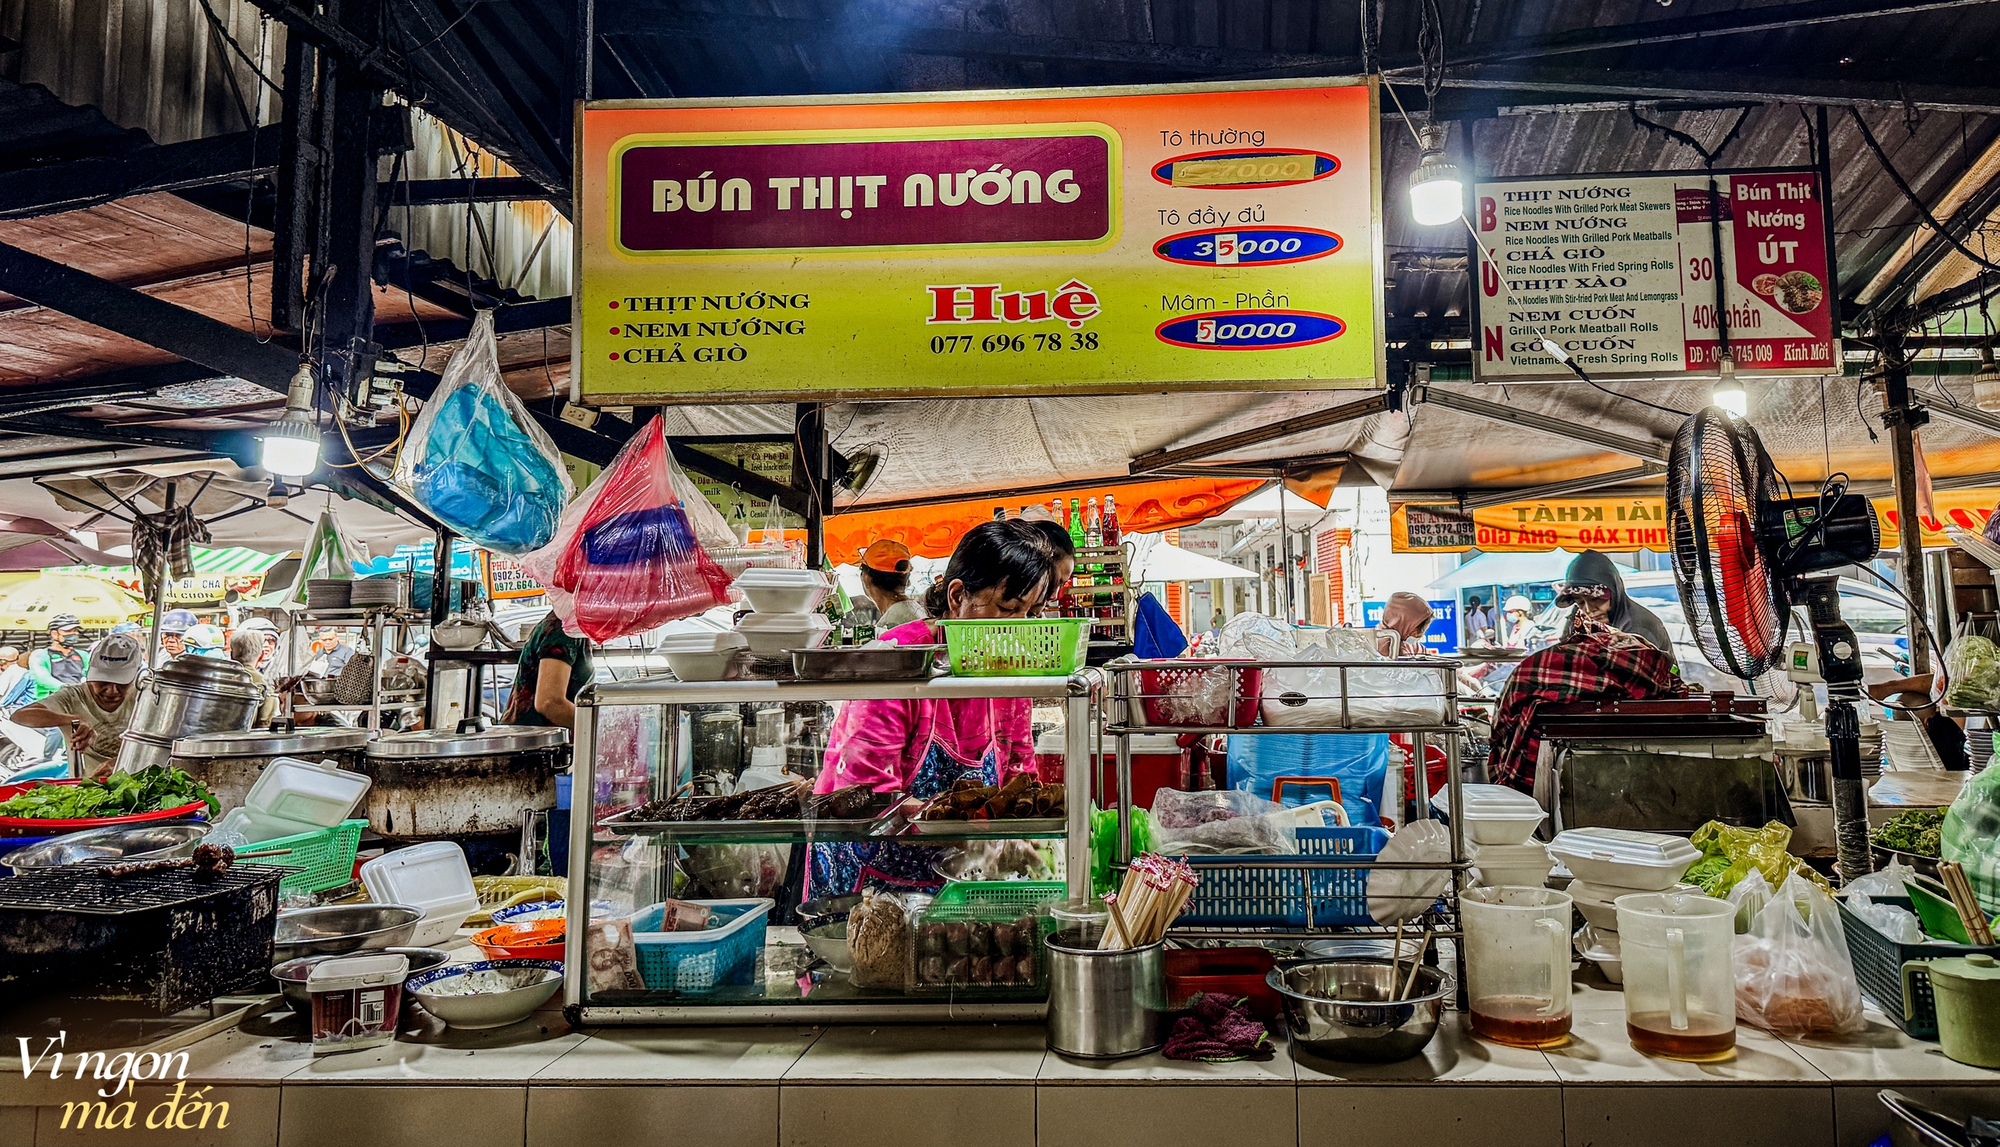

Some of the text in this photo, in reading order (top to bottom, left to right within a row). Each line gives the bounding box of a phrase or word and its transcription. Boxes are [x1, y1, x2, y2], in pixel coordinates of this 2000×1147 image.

[1160, 128, 1265, 147] Tô thường
[652, 163, 1081, 219] BÚN THỊT NƯỚNG
[1503, 186, 1632, 204] THỊT NƯỚNG
[1737, 182, 1811, 204] Bún Thịt
[1158, 204, 1266, 227] Tô đầy đủ
[1504, 206, 1521, 216] Rice
[1522, 205, 1553, 215] Noodles
[1555, 204, 1572, 214] With
[1573, 203, 1599, 213] Grilled
[1600, 202, 1618, 212] Pork
[1619, 202, 1637, 212] Meat
[1639, 201, 1671, 211] Skewers
[1505, 216, 1627, 232] NEM NƯỚNG
[1747, 209, 1806, 230] Nướng
[1193, 238, 1302, 257] 35000
[1505, 231, 1673, 246] Rice Noodles With Grilled Pork Meatballs
[1506, 245, 1605, 262] CHẢ GIÒ
[1758, 234, 1799, 265] ÚT
[1507, 260, 1674, 275] Rice Noodles With Fried Spring Rolls
[1507, 275, 1627, 292] THỊT XÀO
[623, 291, 811, 315] THỊT NƯỚNG
[926, 278, 1102, 330] Huệ
[1161, 294, 1216, 312] Mâm
[1236, 289, 1289, 309] Phần
[1523, 295, 1548, 305] Noodles
[1549, 294, 1564, 304] With
[1565, 293, 1592, 304] Stir-fried
[1594, 293, 1609, 303] Pork
[1610, 292, 1625, 302] Meat
[1626, 292, 1639, 302] And
[1640, 292, 1678, 303] Lemongrass
[1508, 304, 1636, 322] NEM CUỐN
[623, 317, 806, 338] NEM NƯỚNG
[1196, 320, 1296, 341] 50000
[1509, 322, 1659, 336] Grilled Pork Meatball Rolls
[930, 332, 1099, 354] 077 696 78 38
[1510, 335, 1636, 352] GỎ CUỐN
[1784, 342, 1830, 361] Kính Mời
[623, 342, 748, 364] CHẢ GIÒ
[1510, 352, 1678, 365] Vietname Fresh Spring Rolls
[1736, 345, 1753, 362] 745
[1755, 344, 1773, 361] 009
